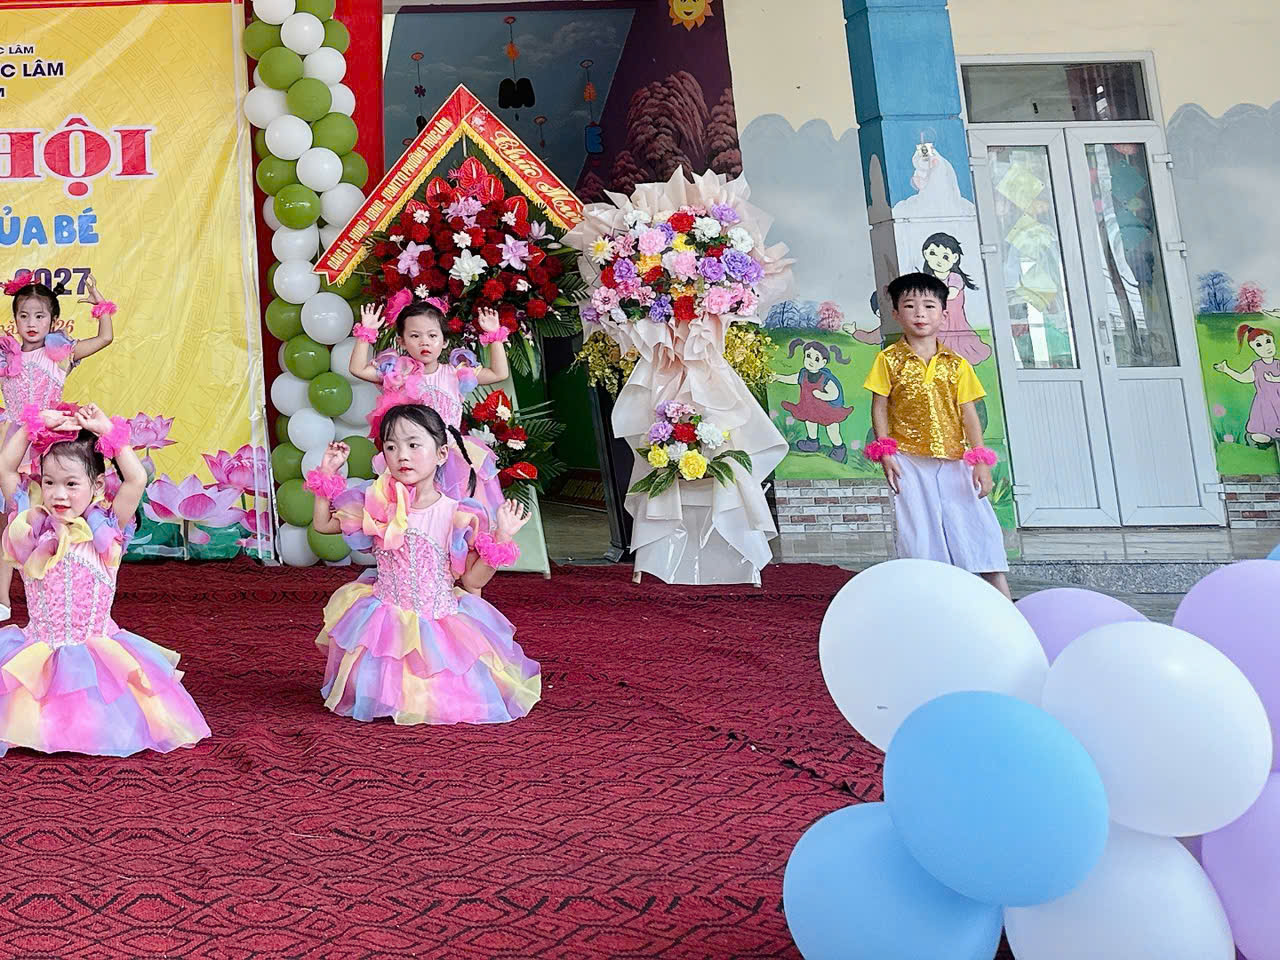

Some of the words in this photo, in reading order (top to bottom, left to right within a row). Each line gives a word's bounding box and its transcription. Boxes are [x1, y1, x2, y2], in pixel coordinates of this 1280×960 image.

[8, 44, 34, 54] LÂM
[23, 59, 64, 77] LÂM
[53, 207, 99, 245] BÉ
